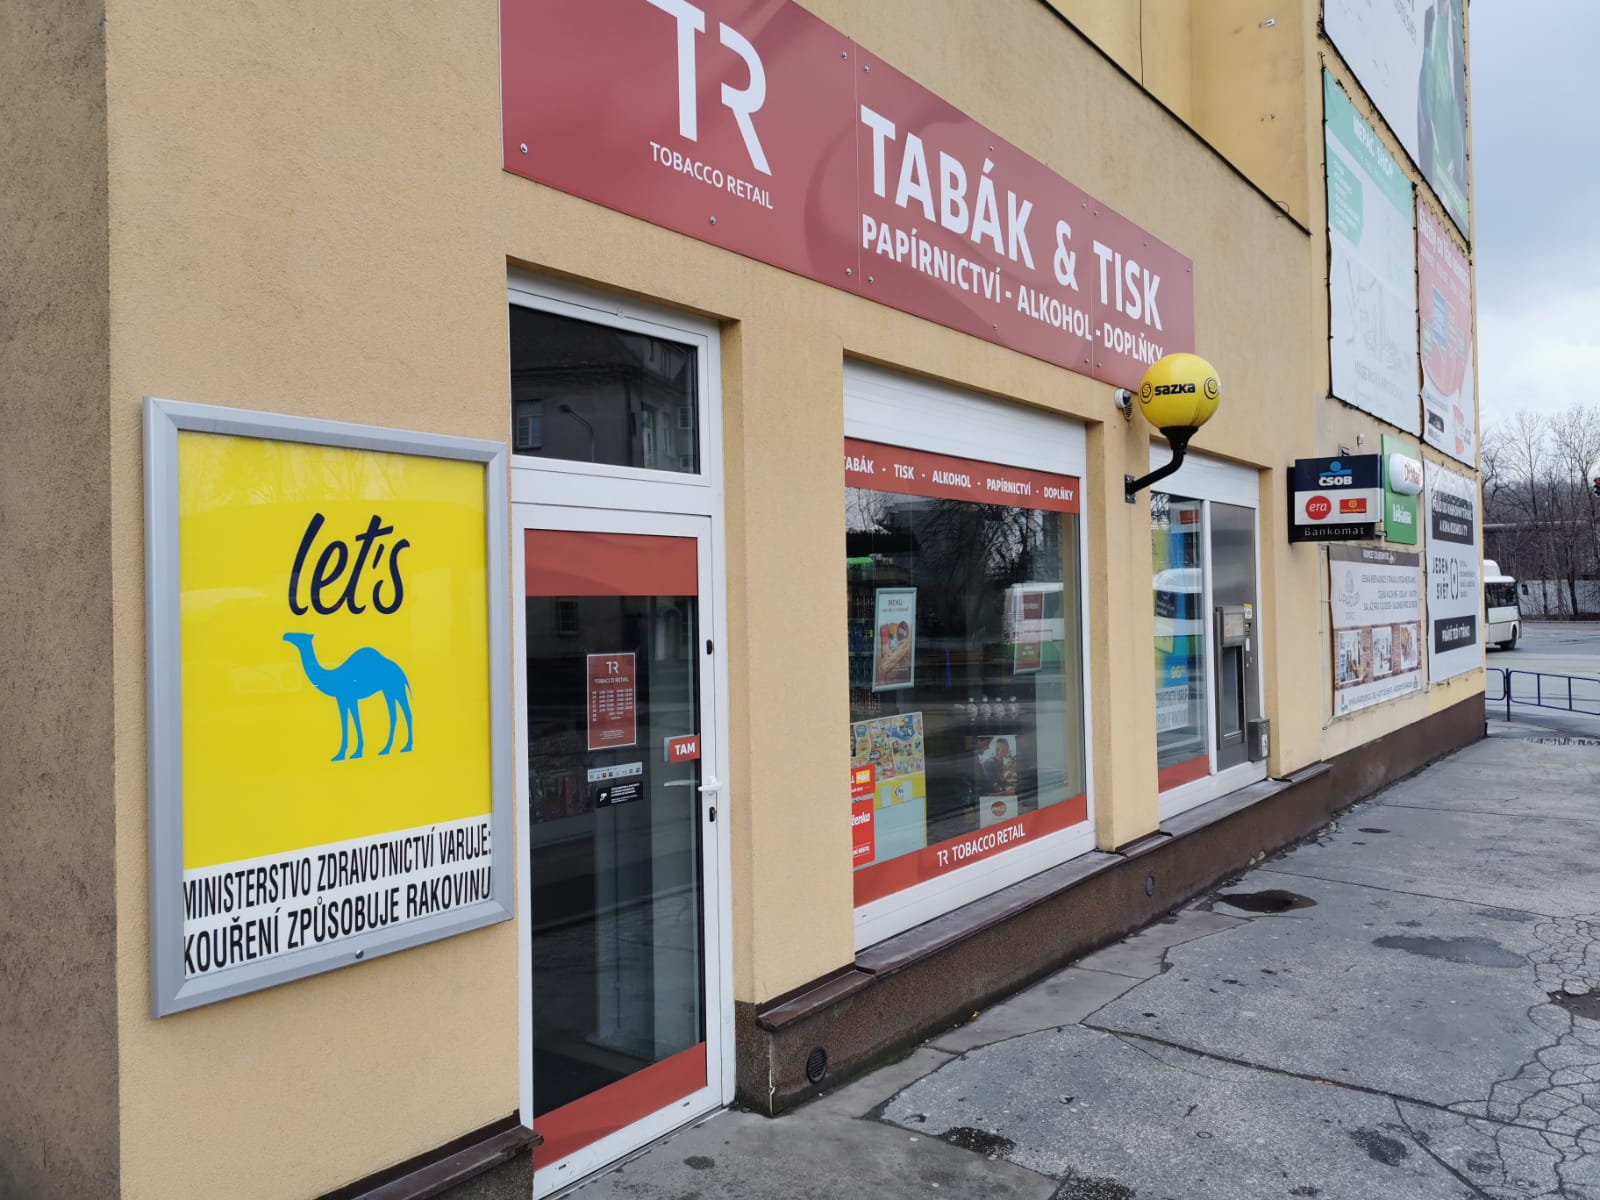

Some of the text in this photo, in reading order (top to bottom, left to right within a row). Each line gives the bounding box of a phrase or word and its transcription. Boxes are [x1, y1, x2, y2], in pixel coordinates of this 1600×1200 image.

[646, 0, 772, 176] TR
[650, 142, 773, 209] TOBACCO RETAIL
[861, 104, 1163, 331] TABÁK & TISK
[862, 214, 1001, 303] PAPÍRNICTVÍ
[1017, 285, 1092, 341] ALKOHOL
[894, 463, 914, 480] TISK
[932, 470, 971, 488] ALKOHOL
[986, 478, 1031, 496] PAPÍRNICTVÍ
[1044, 486, 1074, 501] DOPLŇKY
[1309, 503, 1327, 512] era
[1318, 475, 1352, 487] ČSOB
[1304, 527, 1365, 536] Bankomat
[288, 513, 411, 615] let's
[606, 661, 619, 674] TR
[675, 742, 695, 756] TAM
[184, 823, 492, 922] MINISTERSTVO ZDRAVOTNICTVÍ VARUJE:
[937, 823, 1026, 867] TR TOBACCO RETAIL
[184, 866, 491, 976] KOUŘENÍ ZPŮSOBUJE RAKOVINU
